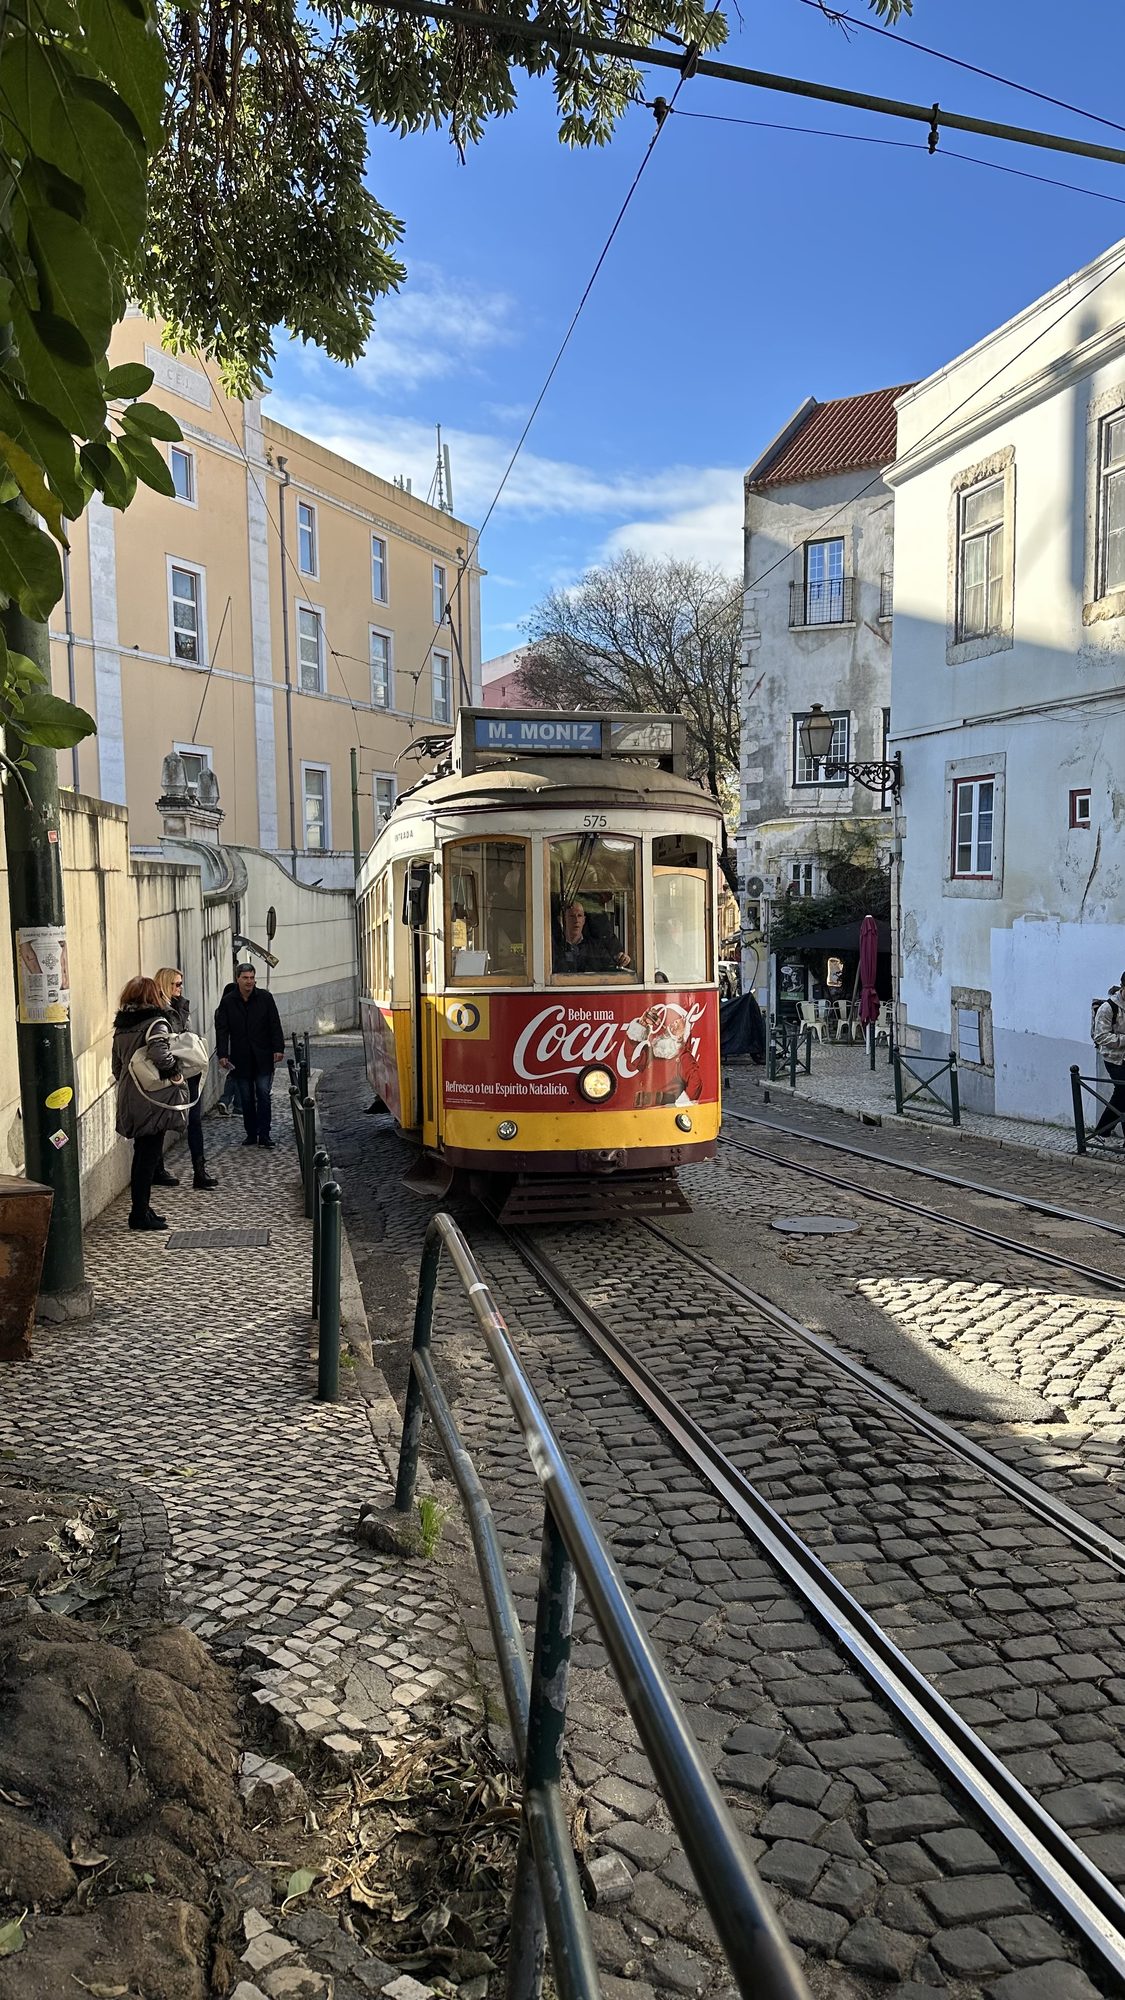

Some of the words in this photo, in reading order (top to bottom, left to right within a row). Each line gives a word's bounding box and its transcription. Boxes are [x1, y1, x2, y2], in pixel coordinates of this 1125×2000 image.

[488, 723, 512, 739] M.
[520, 723, 593, 741] MONIZ
[583, 815, 607, 828] 575
[568, 1008, 592, 1021] Bebe
[593, 1010, 615, 1021] uma
[445, 1081, 474, 1094] Refresca
[475, 1085, 480, 1094] o
[481, 1083, 494, 1095] teu
[495, 1083, 528, 1097] Espírito
[529, 1083, 569, 1096] Natalício.
